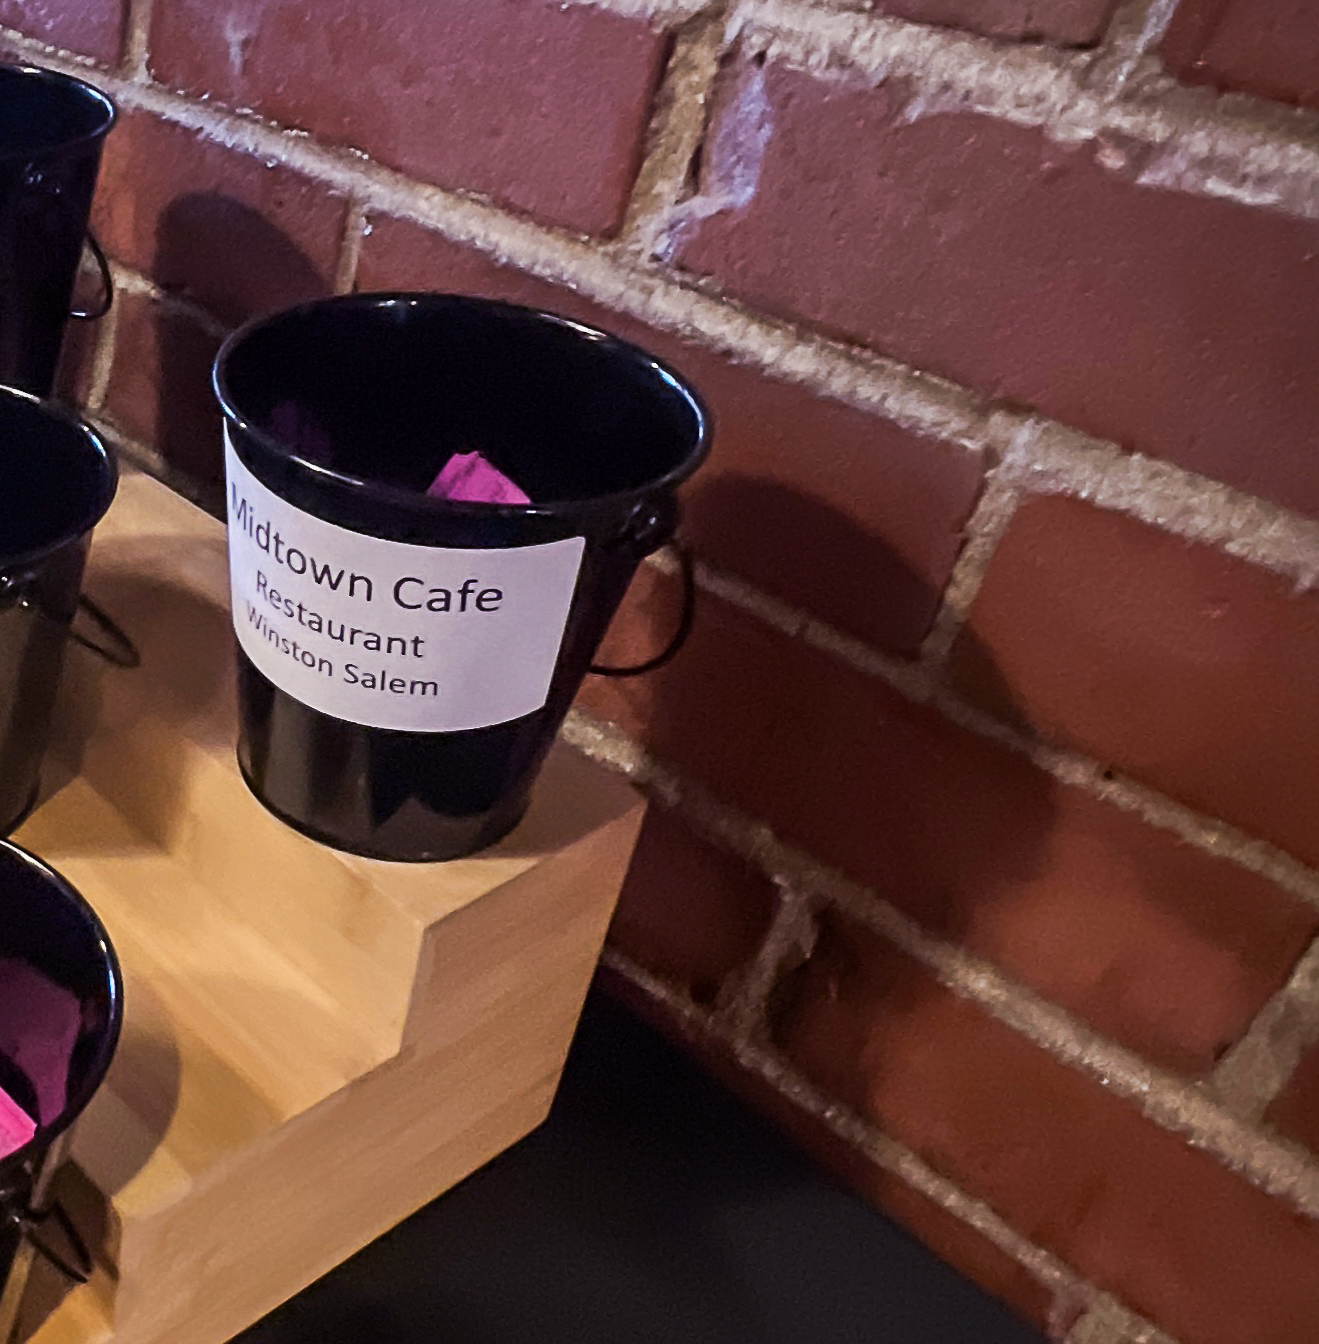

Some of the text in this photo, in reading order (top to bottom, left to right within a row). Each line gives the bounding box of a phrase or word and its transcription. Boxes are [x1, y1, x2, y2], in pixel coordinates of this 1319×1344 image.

[231, 482, 503, 613] Midtown Cafe
[246, 600, 439, 697] Winston Salem
[256, 569, 425, 658] Restaurant
